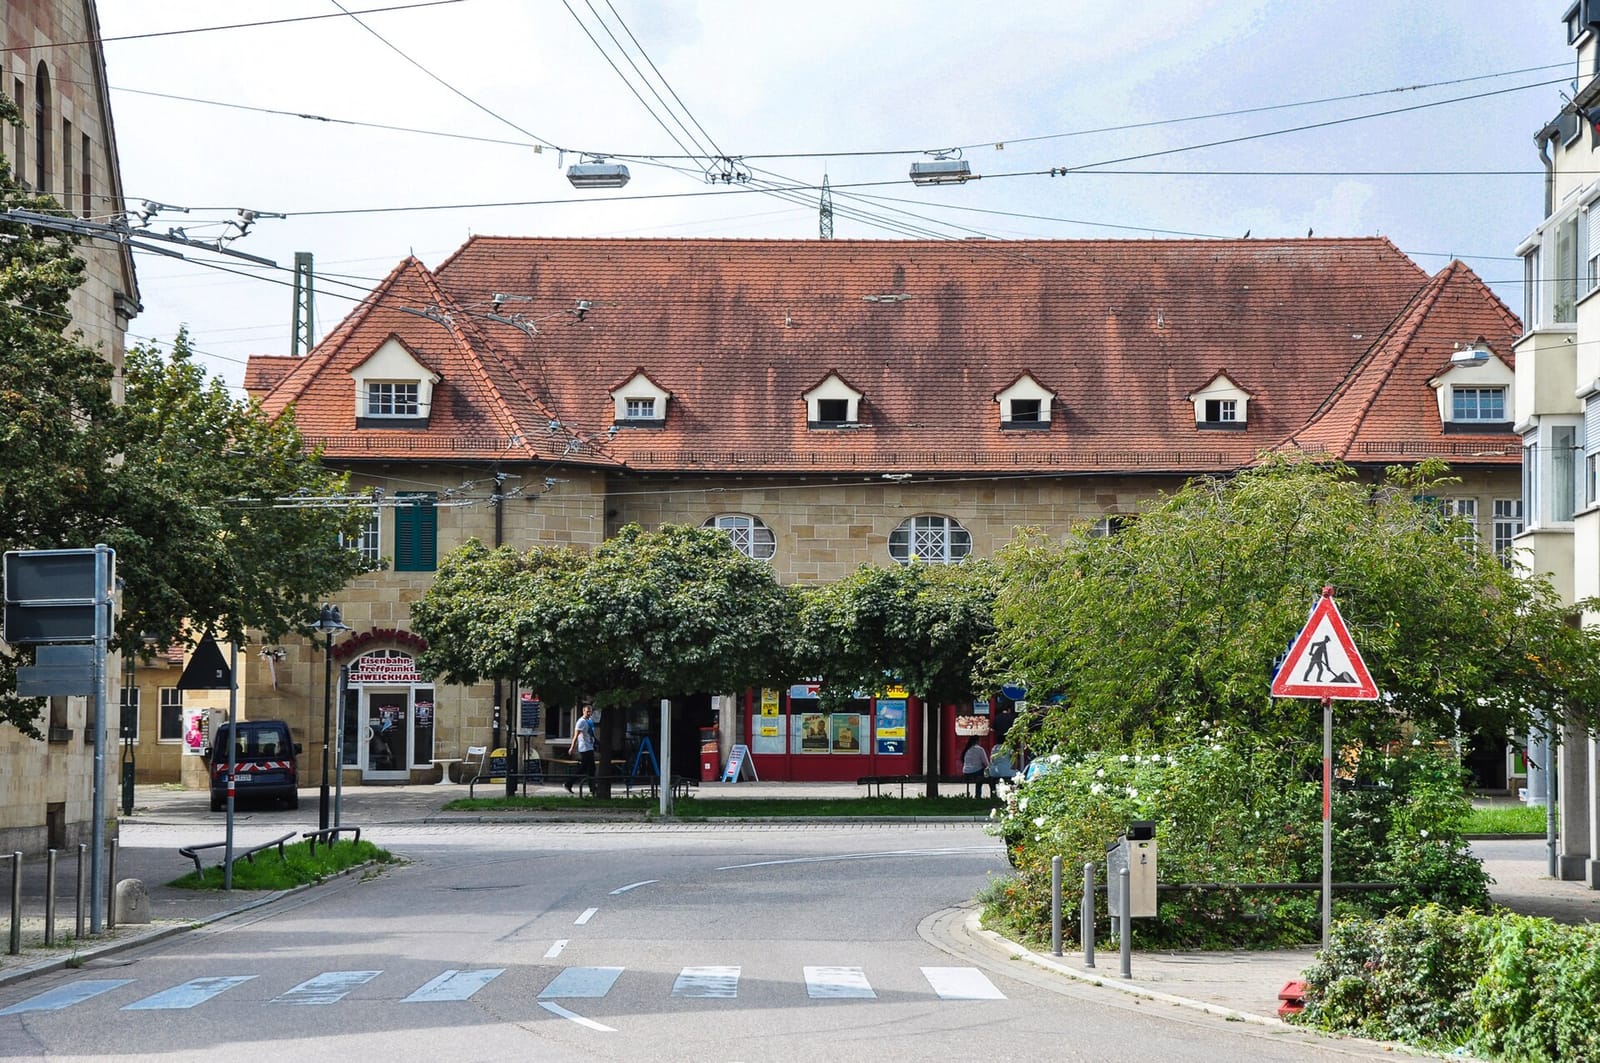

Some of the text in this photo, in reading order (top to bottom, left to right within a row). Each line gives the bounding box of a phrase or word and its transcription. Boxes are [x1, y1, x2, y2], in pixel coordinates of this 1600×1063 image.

[332, 626, 428, 661] Spielware
[360, 657, 413, 665] Eisenbahn-
[359, 665, 414, 673] Treffpunkt
